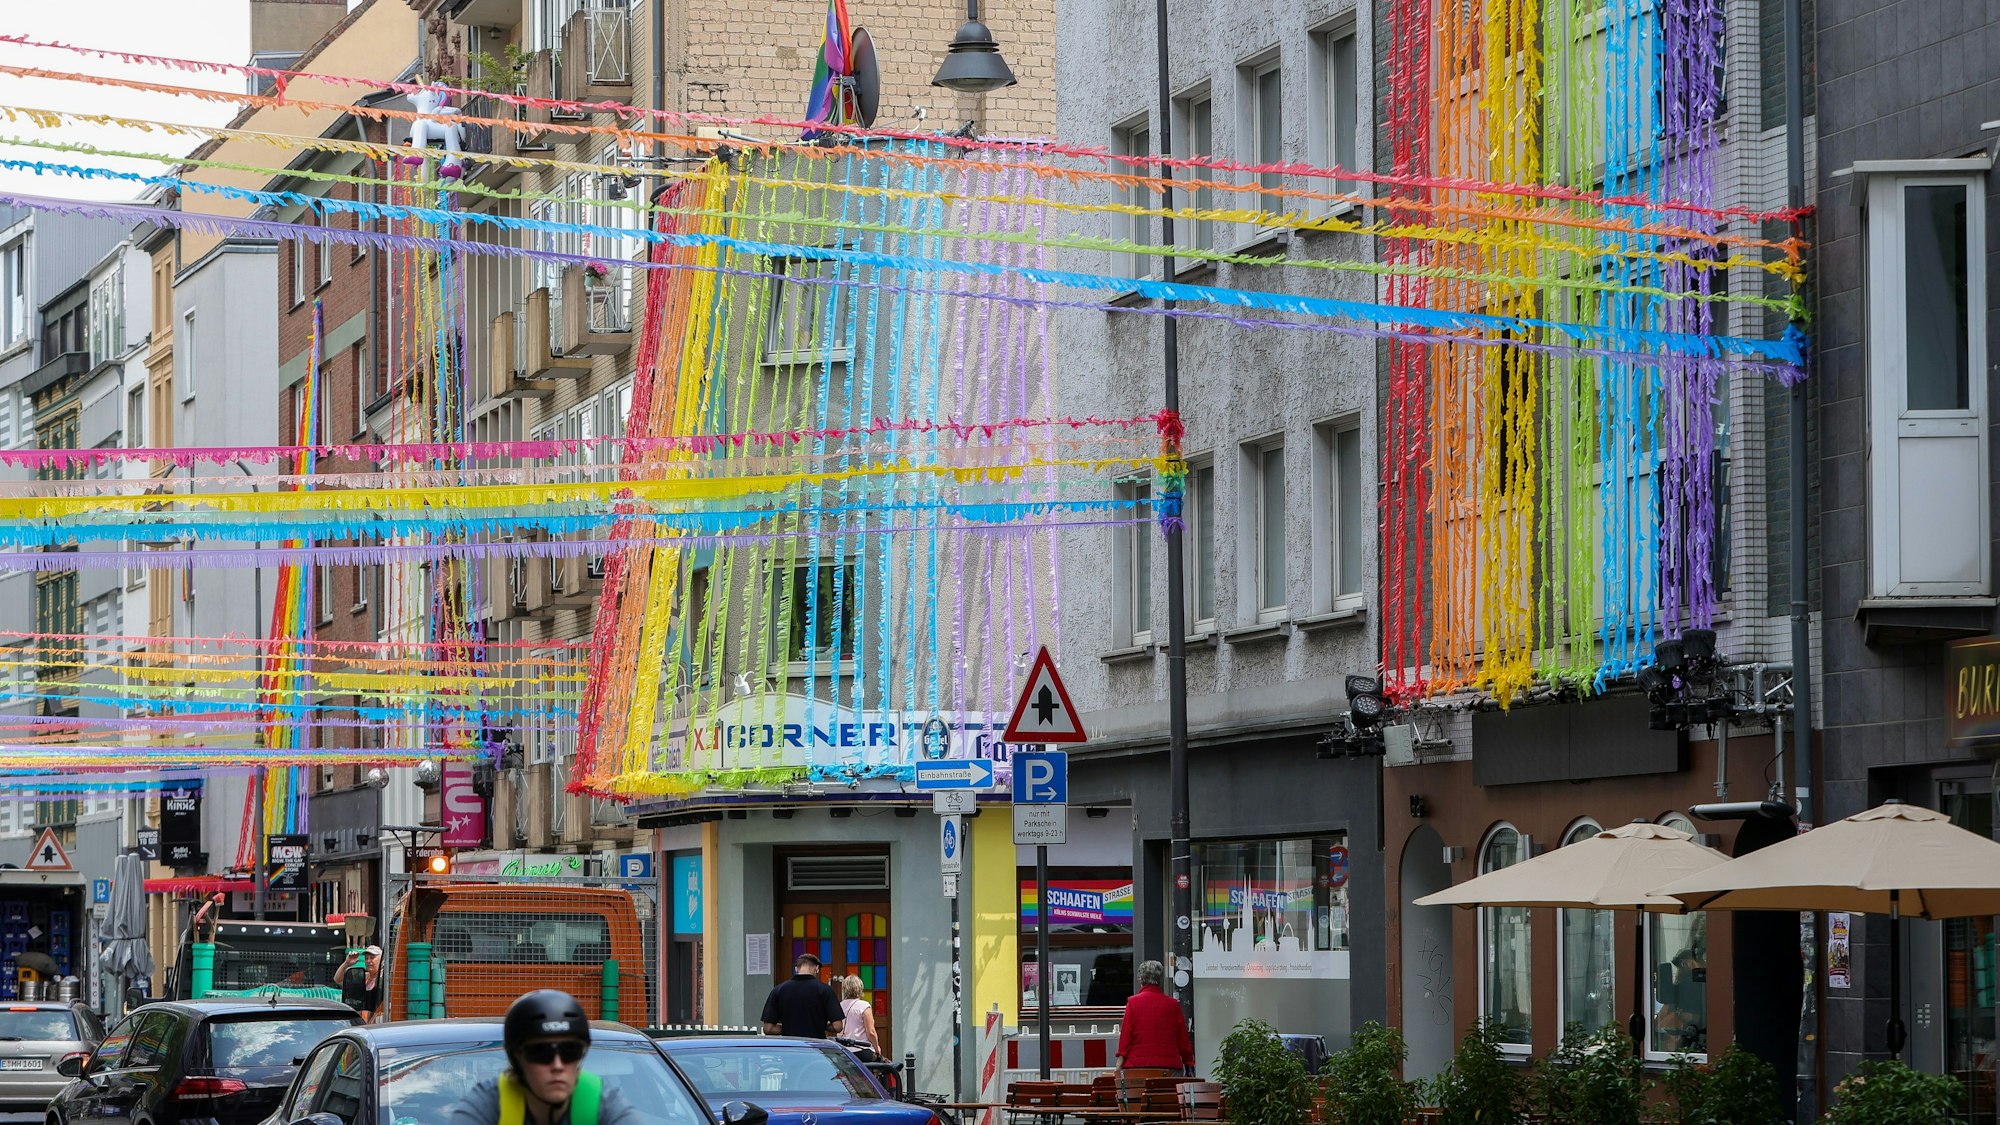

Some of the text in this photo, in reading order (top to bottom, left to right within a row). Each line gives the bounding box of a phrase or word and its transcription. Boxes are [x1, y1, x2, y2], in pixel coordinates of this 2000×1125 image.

[1956, 663, 2000, 719] BUR
[920, 770, 972, 779] Einbahnstraße
[1025, 759, 1054, 801] P
[1040, 810, 1051, 818] mit
[1024, 820, 1057, 828] Parkschein
[1017, 829, 1064, 838] werktags 9-23 h
[1047, 890, 1101, 910] SCHAAFEN
[1104, 886, 1132, 902] STRASSE
